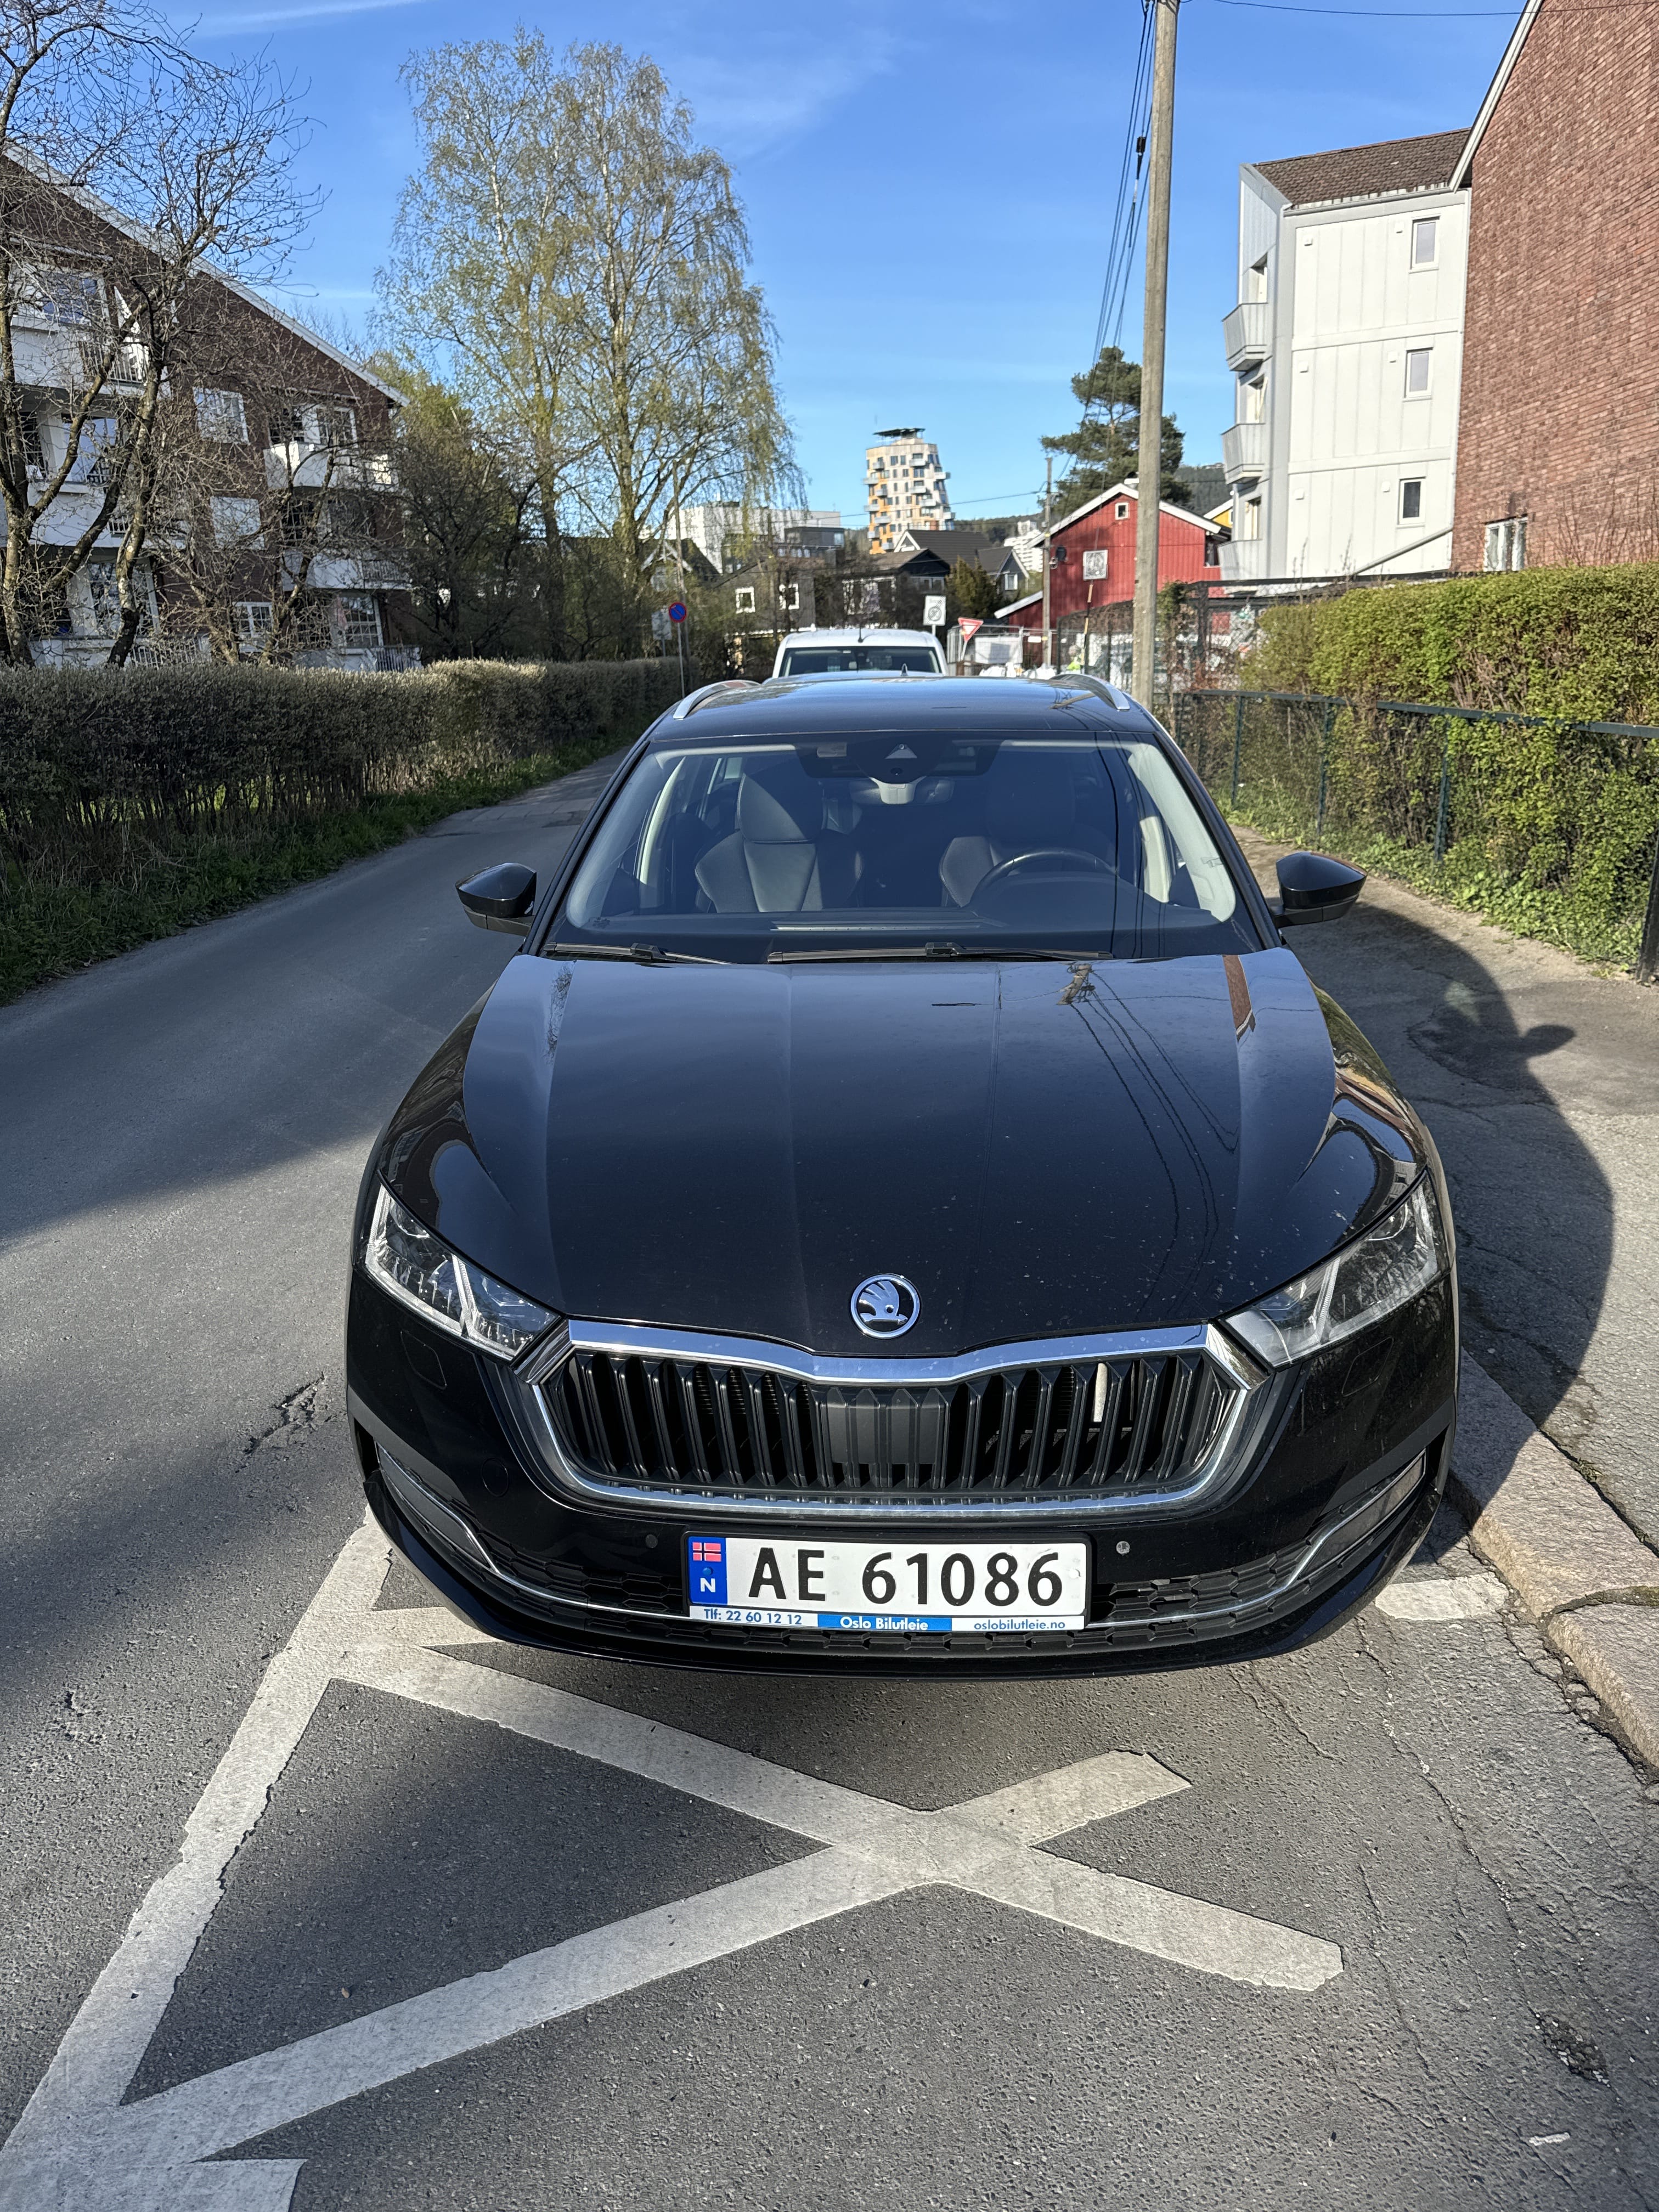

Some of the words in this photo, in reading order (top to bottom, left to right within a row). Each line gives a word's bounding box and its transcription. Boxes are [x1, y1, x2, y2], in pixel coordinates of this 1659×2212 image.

[748, 1547, 826, 1601] AE
[862, 1551, 1063, 1606] 61086
[700, 1577, 716, 1593] N
[704, 1609, 722, 1620] Tlf:
[726, 1610, 741, 1621] 22
[746, 1611, 761, 1622] 60
[767, 1613, 782, 1623] 12
[787, 1614, 802, 1625] 12
[840, 1616, 871, 1629] Oslo
[876, 1617, 928, 1630] Bilutleie
[974, 1619, 1065, 1630] oslobilutleie.no
